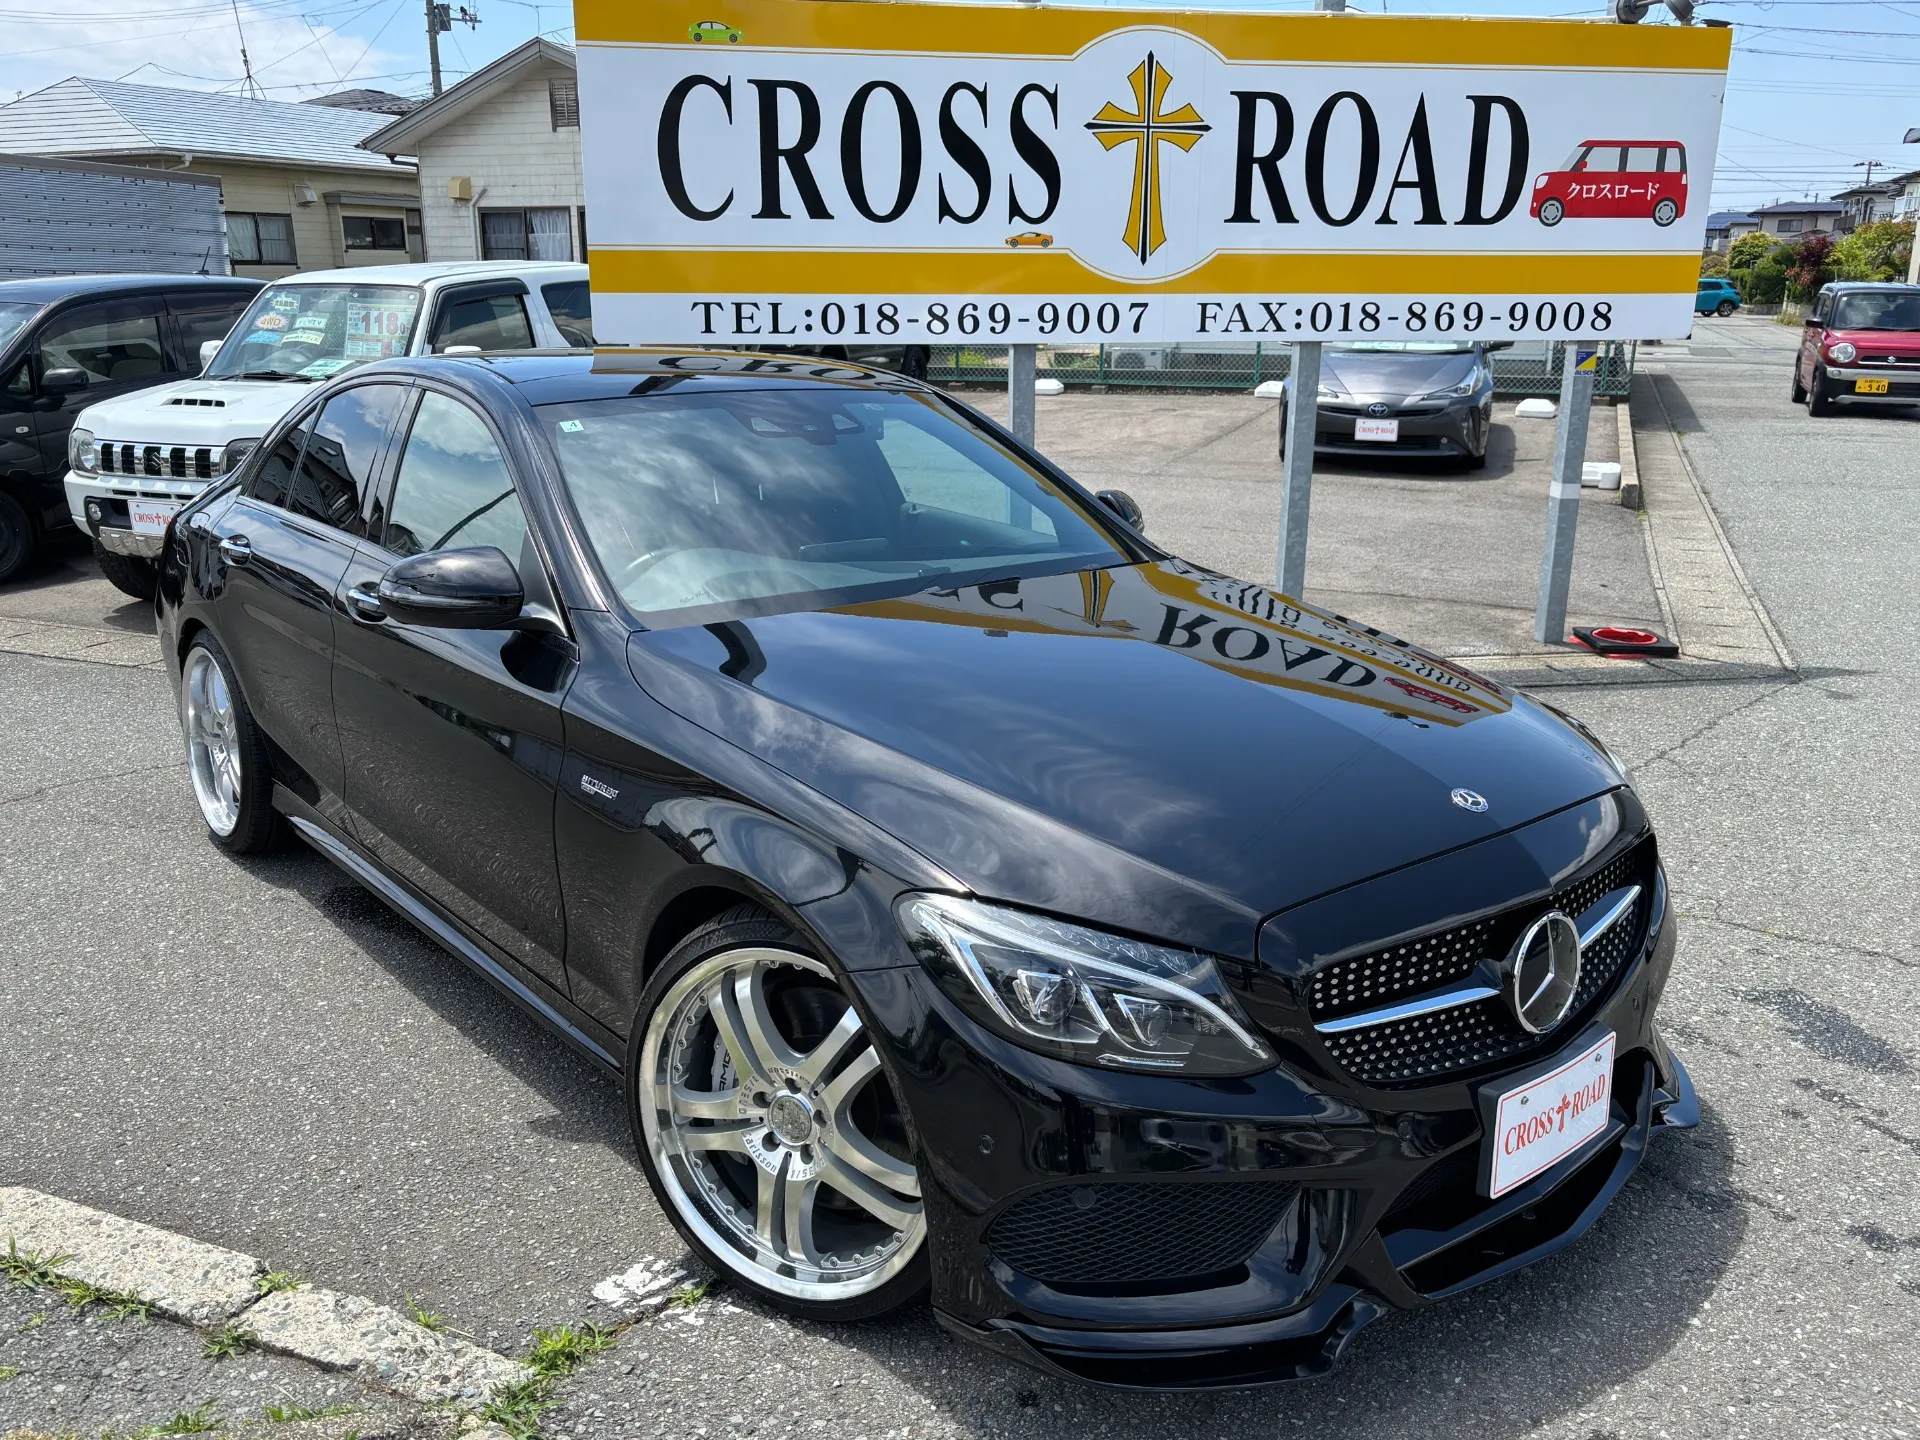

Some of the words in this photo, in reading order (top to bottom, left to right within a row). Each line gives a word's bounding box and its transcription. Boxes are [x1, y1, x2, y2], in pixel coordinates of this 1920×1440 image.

[657, 75, 1061, 225] CROSS
[1224, 91, 1530, 227] ROAD
[1566, 182, 1660, 201] クロスロード
[260, 317, 281, 326] 4WD
[691, 301, 1149, 335] TEL:018-869-9007
[1195, 302, 1612, 333] FAX:018-869-9008
[134, 512, 155, 524] CROSS
[161, 514, 172, 526] RO
[581, 774, 619, 798] BITURBO
[1504, 1107, 1555, 1156] CROSS
[1570, 1073, 1606, 1119] ROAD
